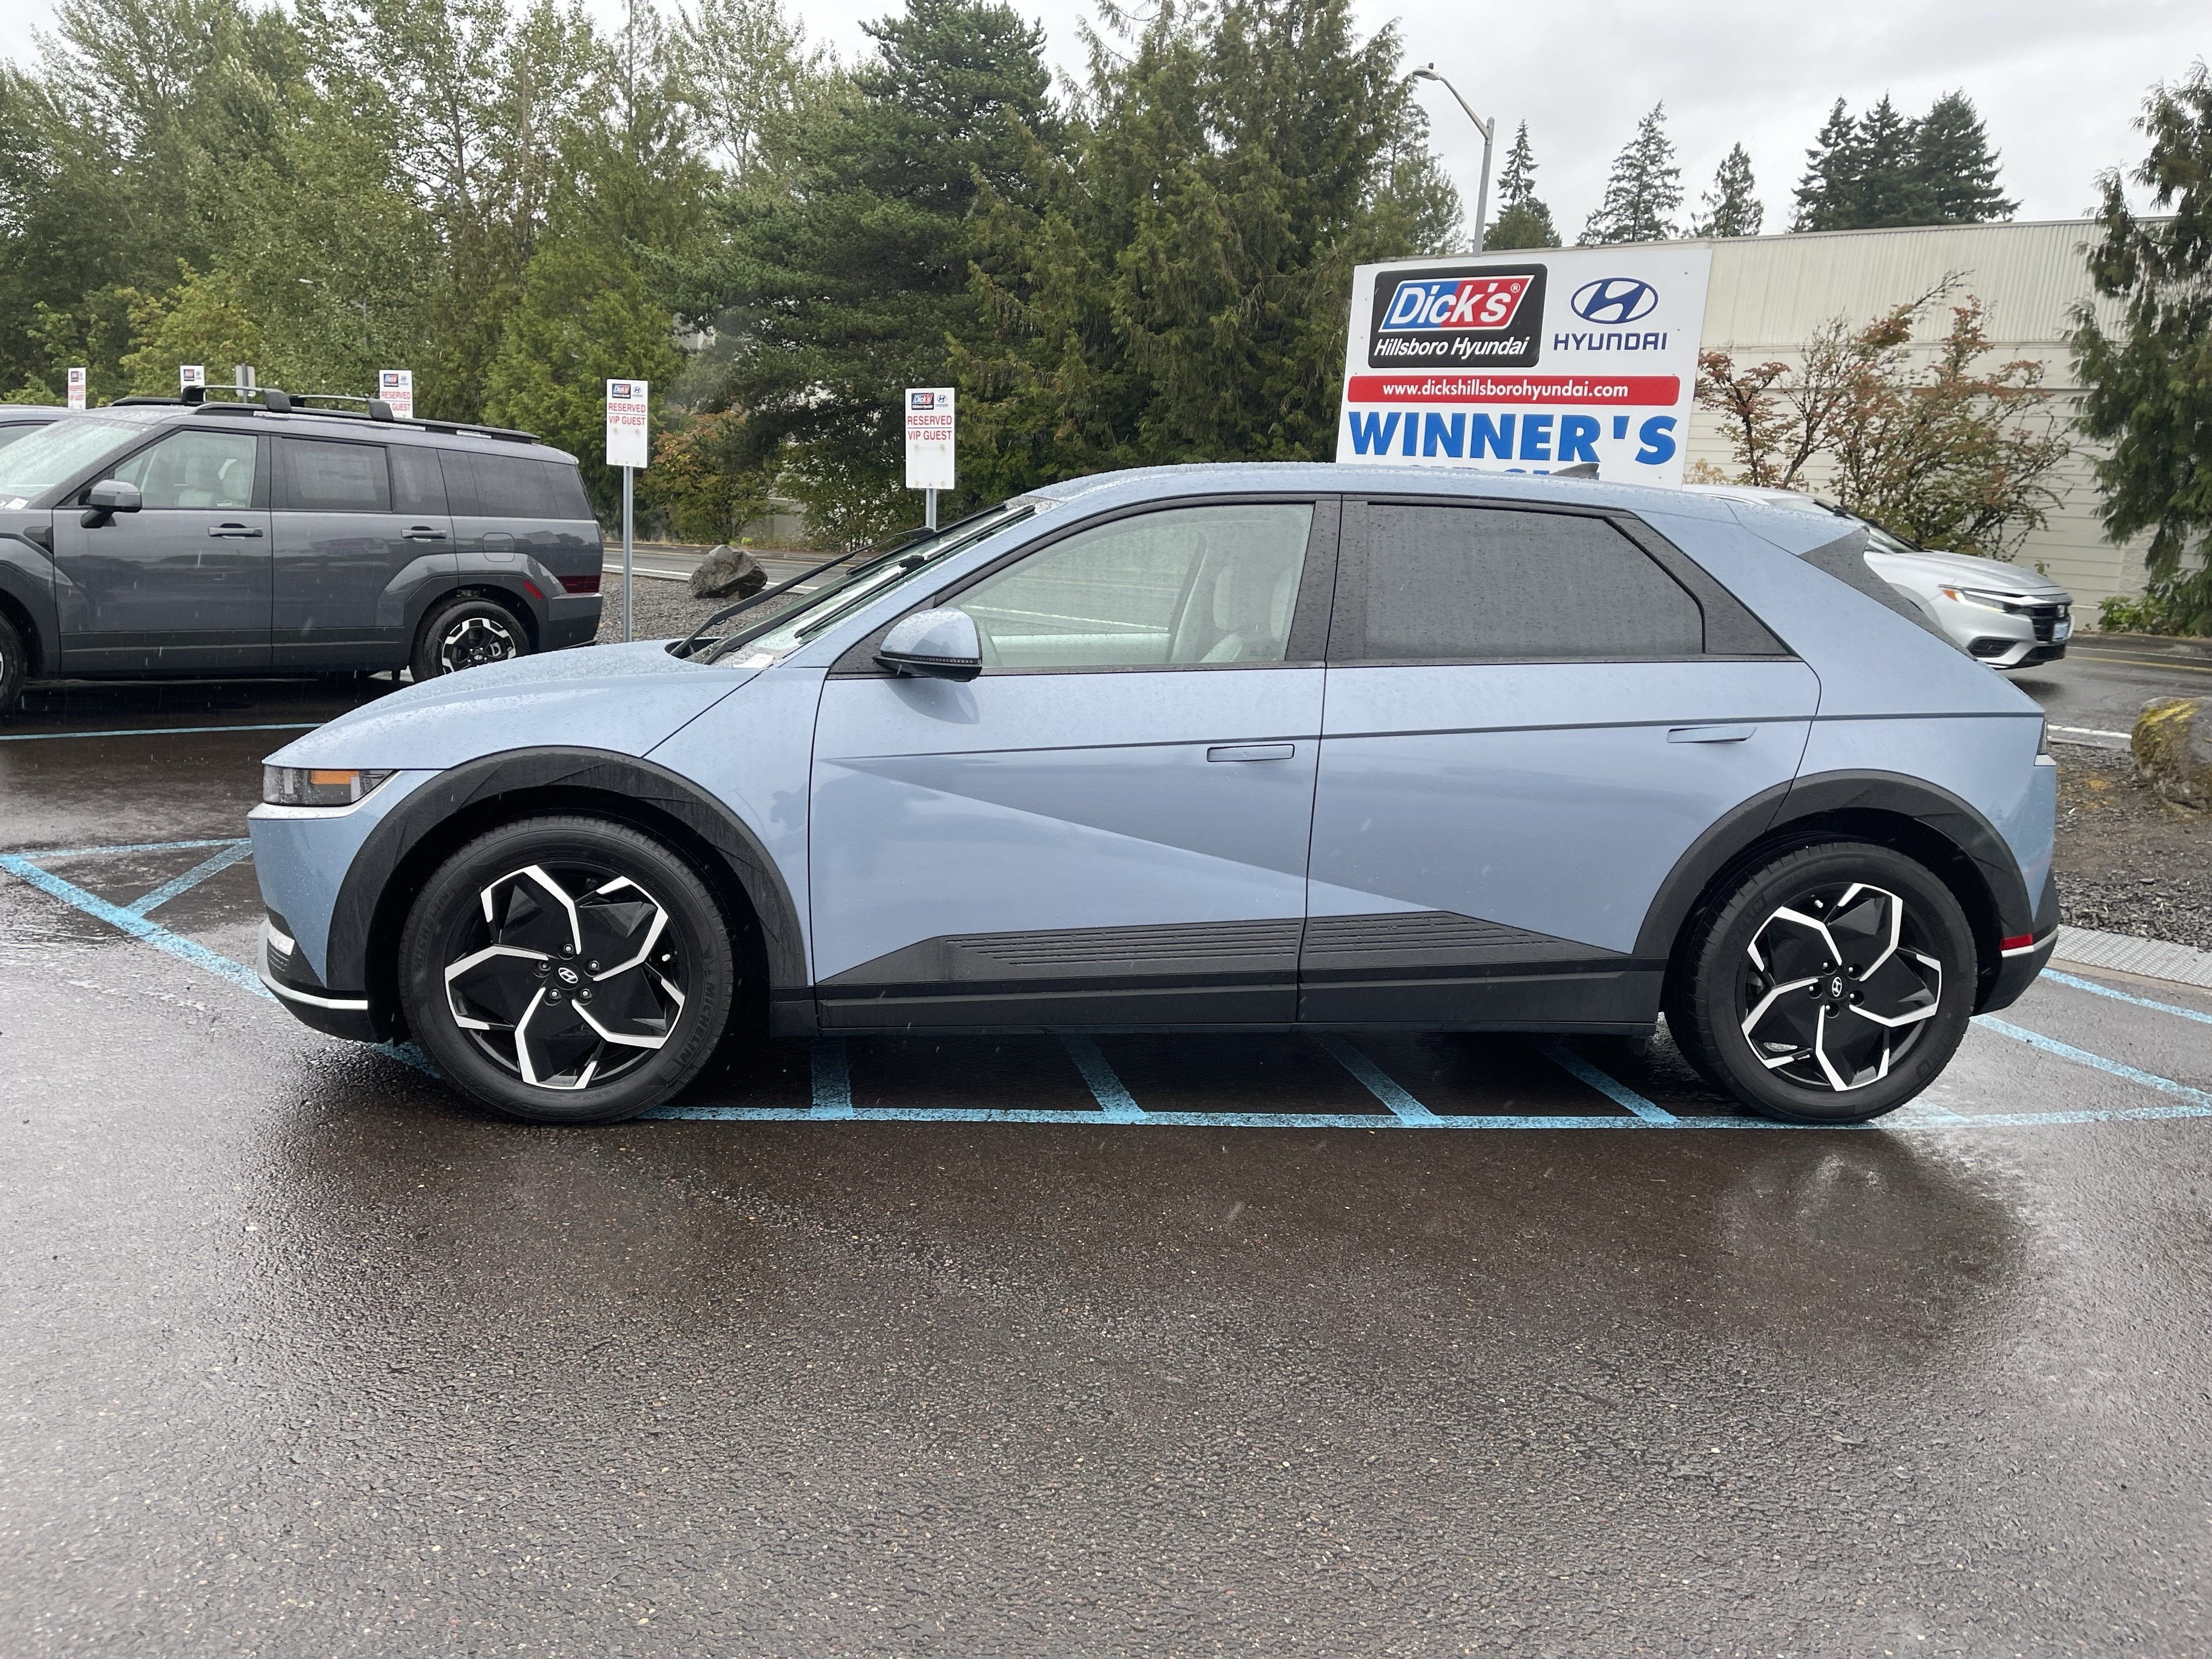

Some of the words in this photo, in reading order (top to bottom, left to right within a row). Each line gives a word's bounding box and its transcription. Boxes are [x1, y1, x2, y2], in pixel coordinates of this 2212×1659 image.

[1554, 332, 1668, 351] HYUNDAI
[1373, 337, 1449, 357] Hillsboro
[1450, 336, 1531, 360] Hyundai
[1383, 379, 1629, 400] www.dickshillsborohyundai.com
[381, 391, 411, 399] RESERVED
[392, 403, 411, 411] GUEST
[608, 403, 646, 413] RESERVED
[608, 415, 620, 424] VIP
[621, 416, 646, 425] GUEST
[907, 415, 952, 425] RESERVED
[908, 431, 921, 440] VIP
[923, 431, 952, 440] GUEST
[1348, 411, 1678, 465] WINNER'S
[679, 981, 716, 1065] MICHELIN
